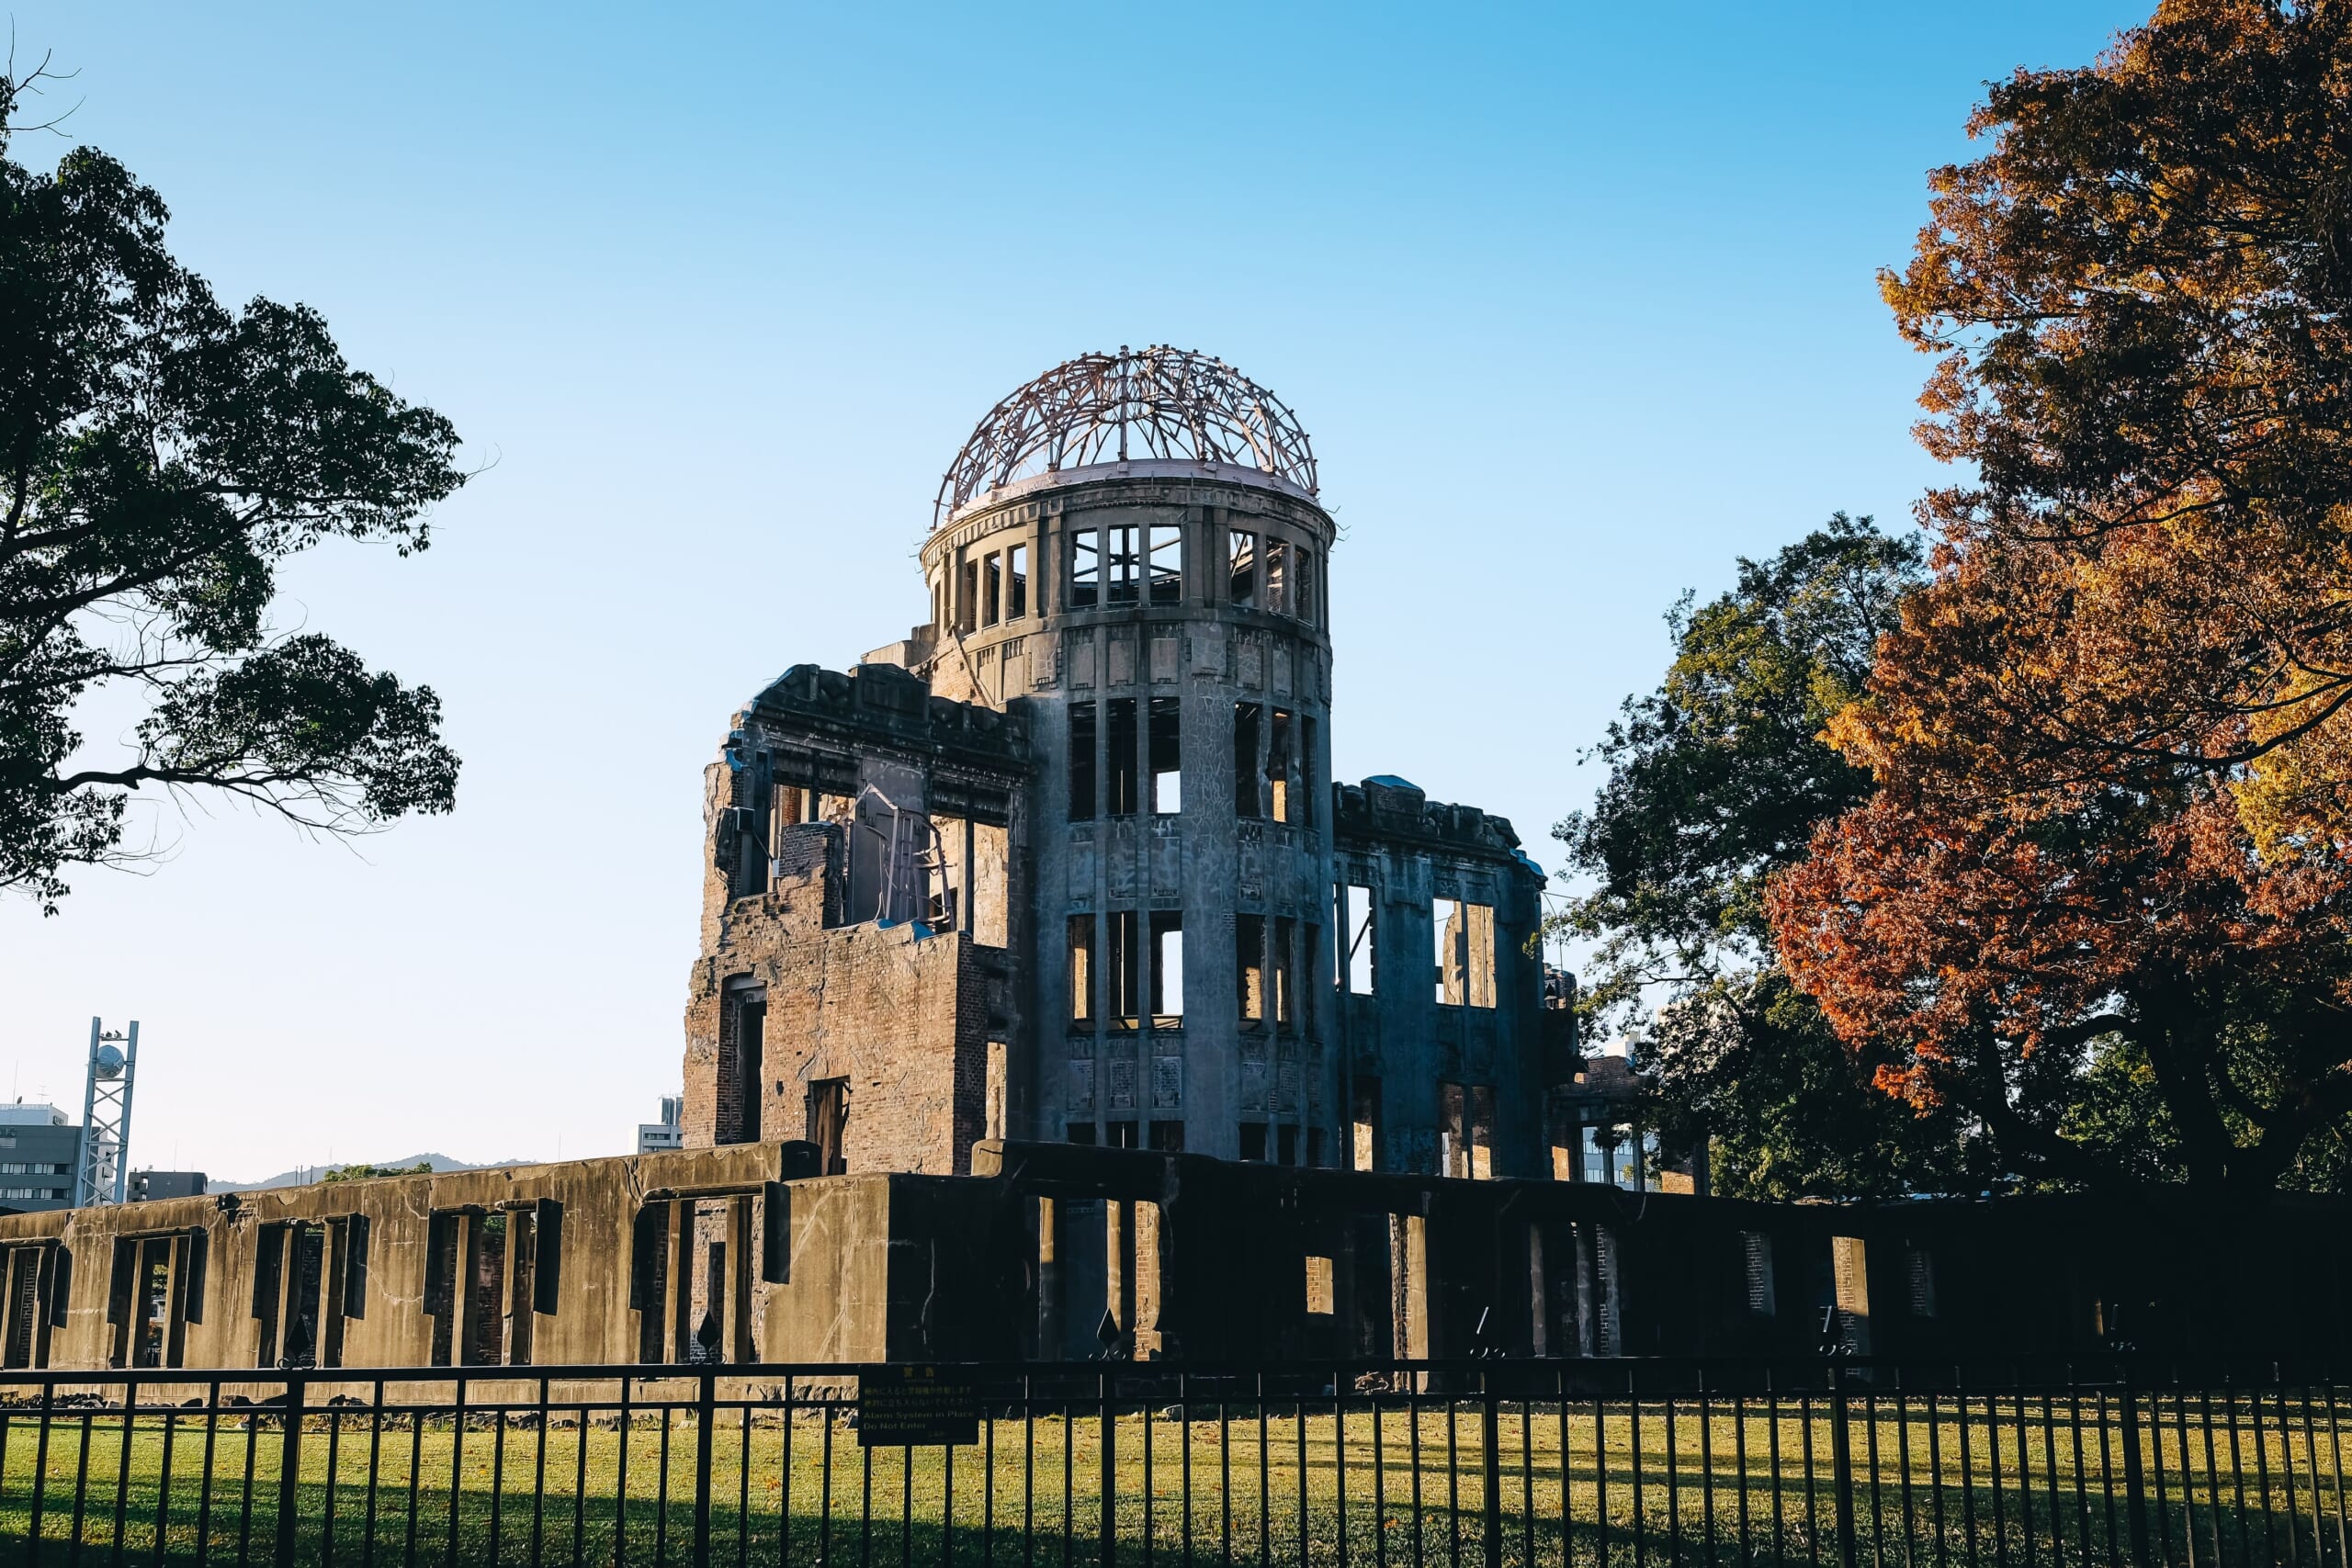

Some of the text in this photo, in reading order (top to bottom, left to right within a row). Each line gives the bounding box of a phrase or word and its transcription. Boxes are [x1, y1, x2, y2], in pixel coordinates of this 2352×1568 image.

[896, 1411, 933, 1420] System
[863, 1422, 877, 1430] Do
[880, 1422, 898, 1430] Not
